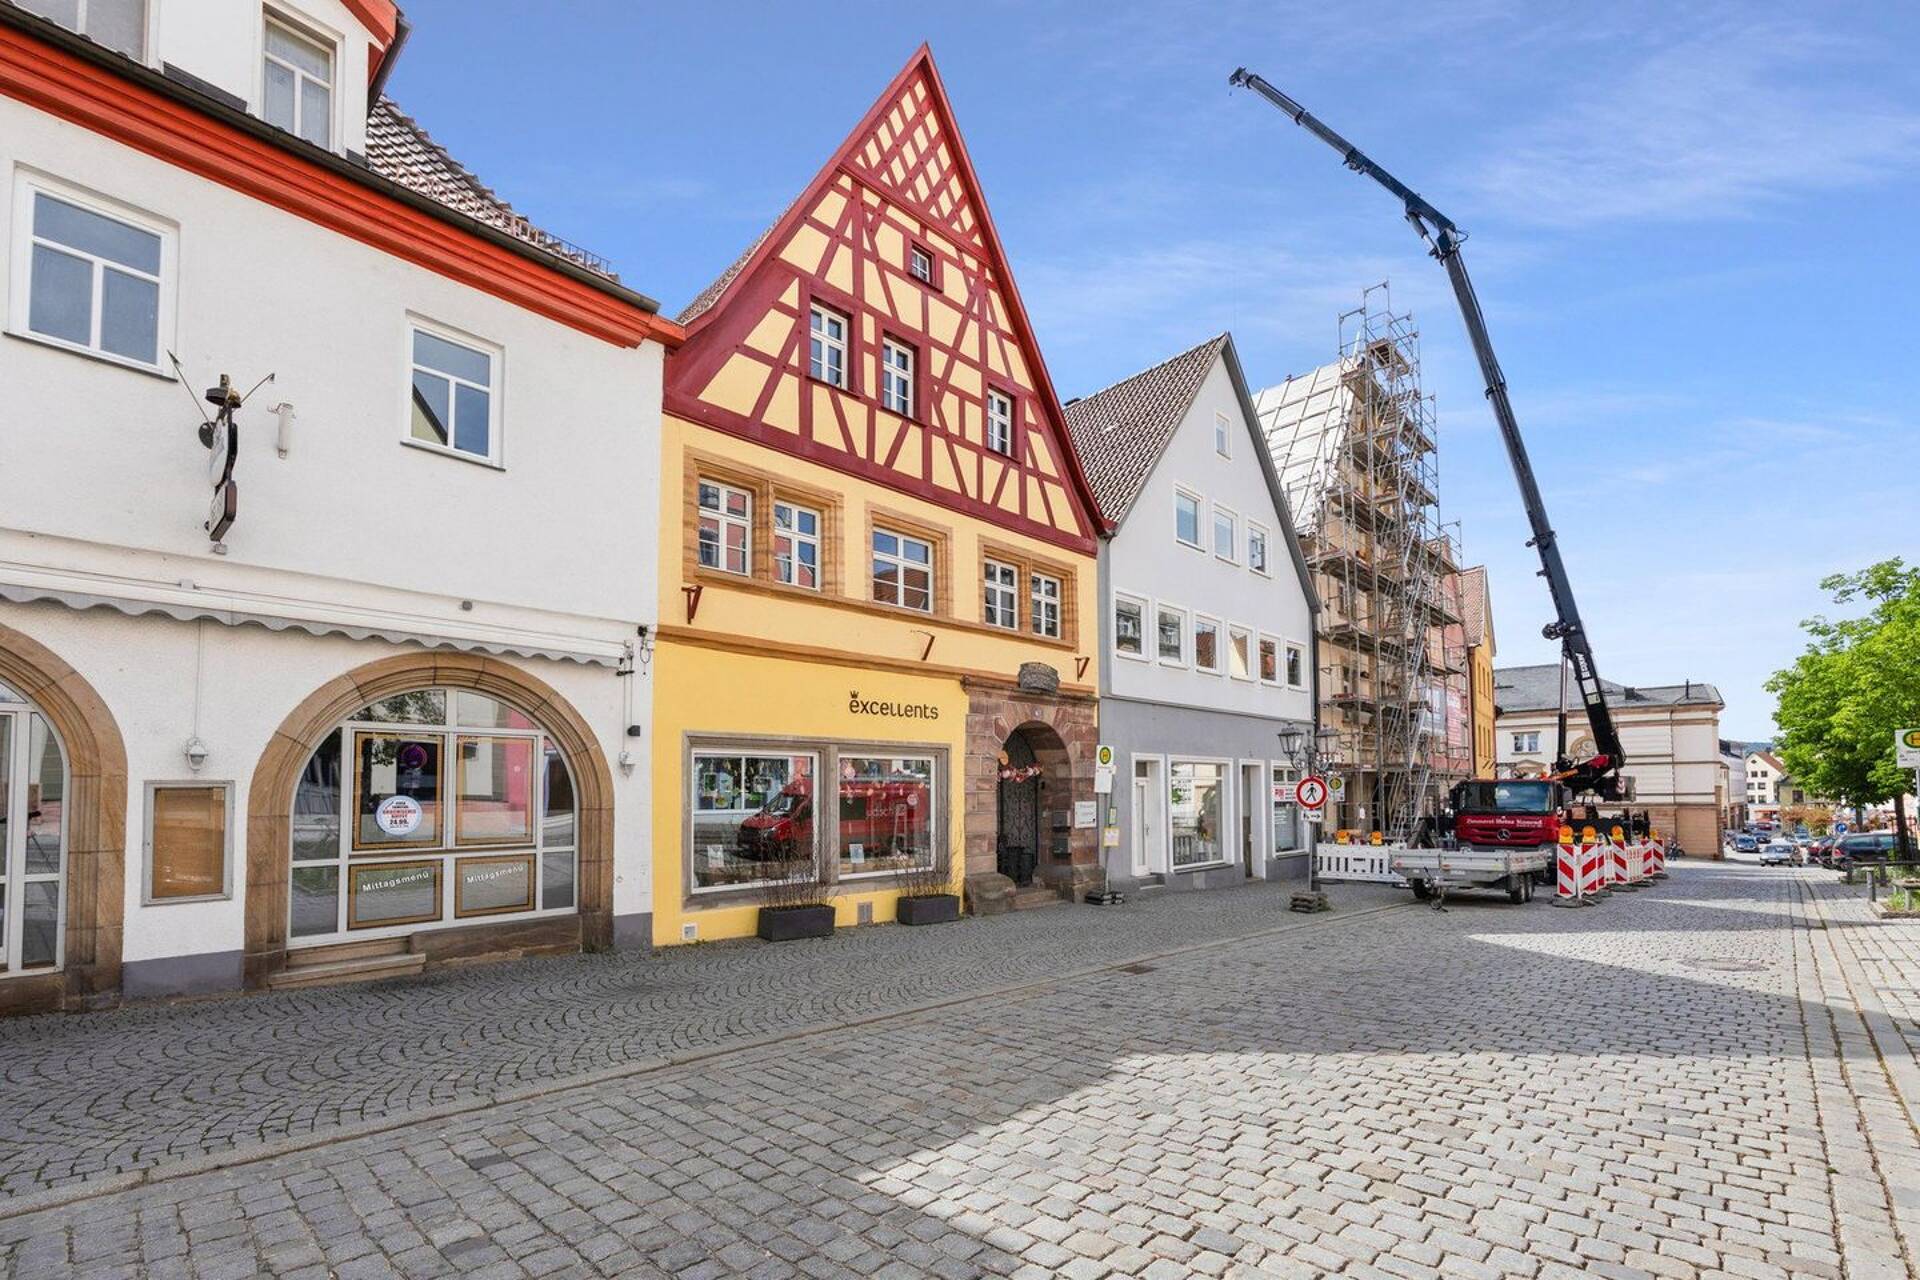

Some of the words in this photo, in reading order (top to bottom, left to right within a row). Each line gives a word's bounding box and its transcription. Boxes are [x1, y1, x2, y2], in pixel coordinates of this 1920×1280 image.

[849, 699, 939, 719] excellents
[362, 870, 430, 892] Mittagsmenü
[466, 864, 524, 884] Mittagsmenü
